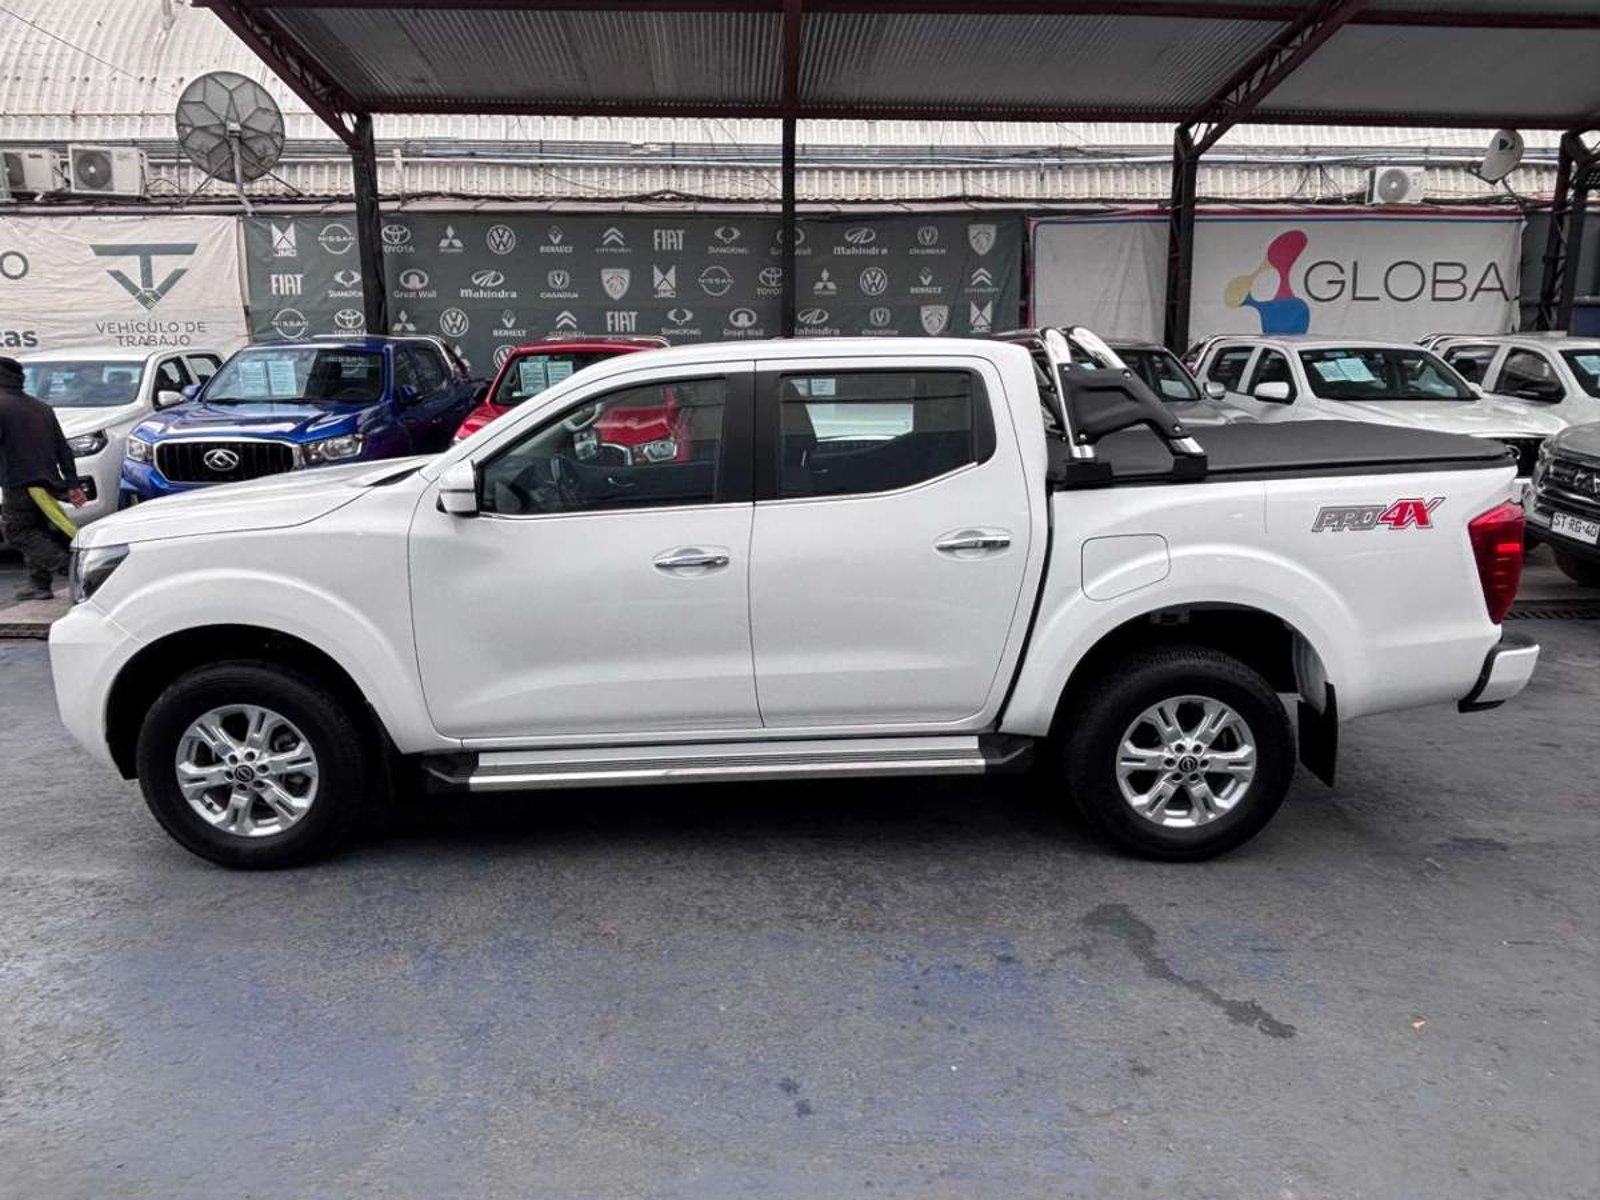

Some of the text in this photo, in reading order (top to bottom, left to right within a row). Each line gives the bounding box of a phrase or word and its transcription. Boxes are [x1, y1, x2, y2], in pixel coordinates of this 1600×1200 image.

[653, 229, 685, 251] FIAT
[833, 246, 888, 255] Mahindra
[271, 273, 304, 296] FIAT
[1303, 260, 1510, 302] GLOBA
[393, 289, 437, 298] Great Wall
[460, 289, 517, 299] Mahindra
[653, 290, 676, 298] JMC
[756, 287, 783, 296] TOYOT
[96, 319, 208, 334] VEHÍCULO DE
[606, 311, 638, 332] FIAT
[794, 327, 840, 336] ahindra
[969, 326, 991, 334] JMC
[116, 335, 191, 347] TRABAJO
